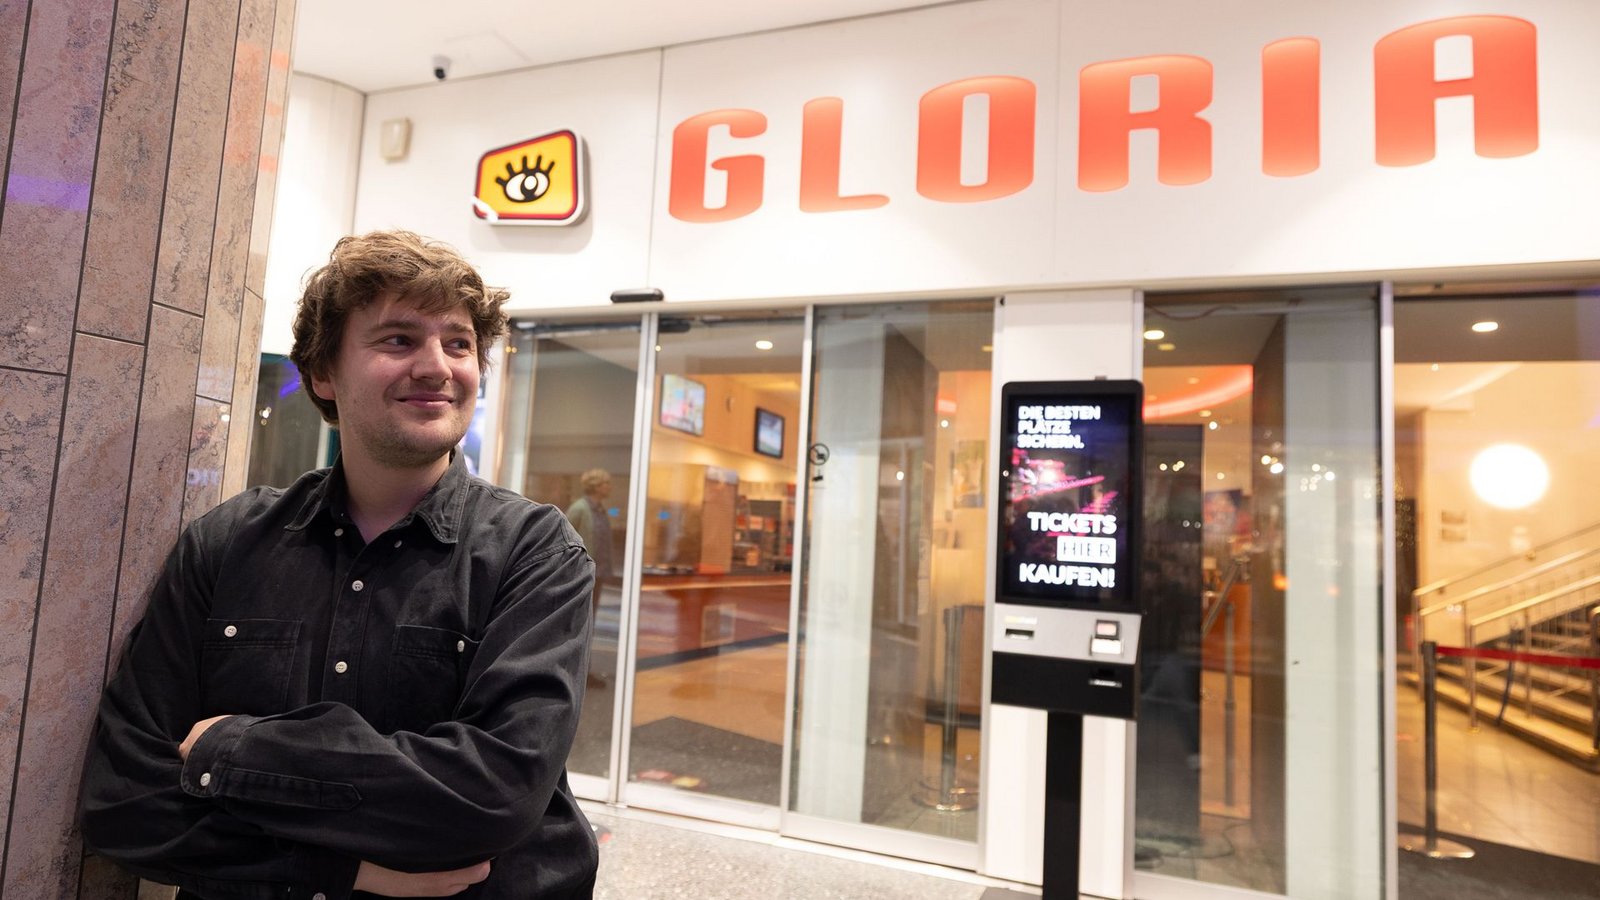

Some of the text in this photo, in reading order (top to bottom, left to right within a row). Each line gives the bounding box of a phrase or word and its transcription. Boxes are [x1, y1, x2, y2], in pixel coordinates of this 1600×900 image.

[668, 14, 1539, 223] GLORIA
[1018, 405, 1101, 421] DIE BESTEN
[1027, 511, 1118, 535] TICKETS
[1061, 540, 1112, 559] HIER
[1019, 562, 1117, 588] KAUFEN!
